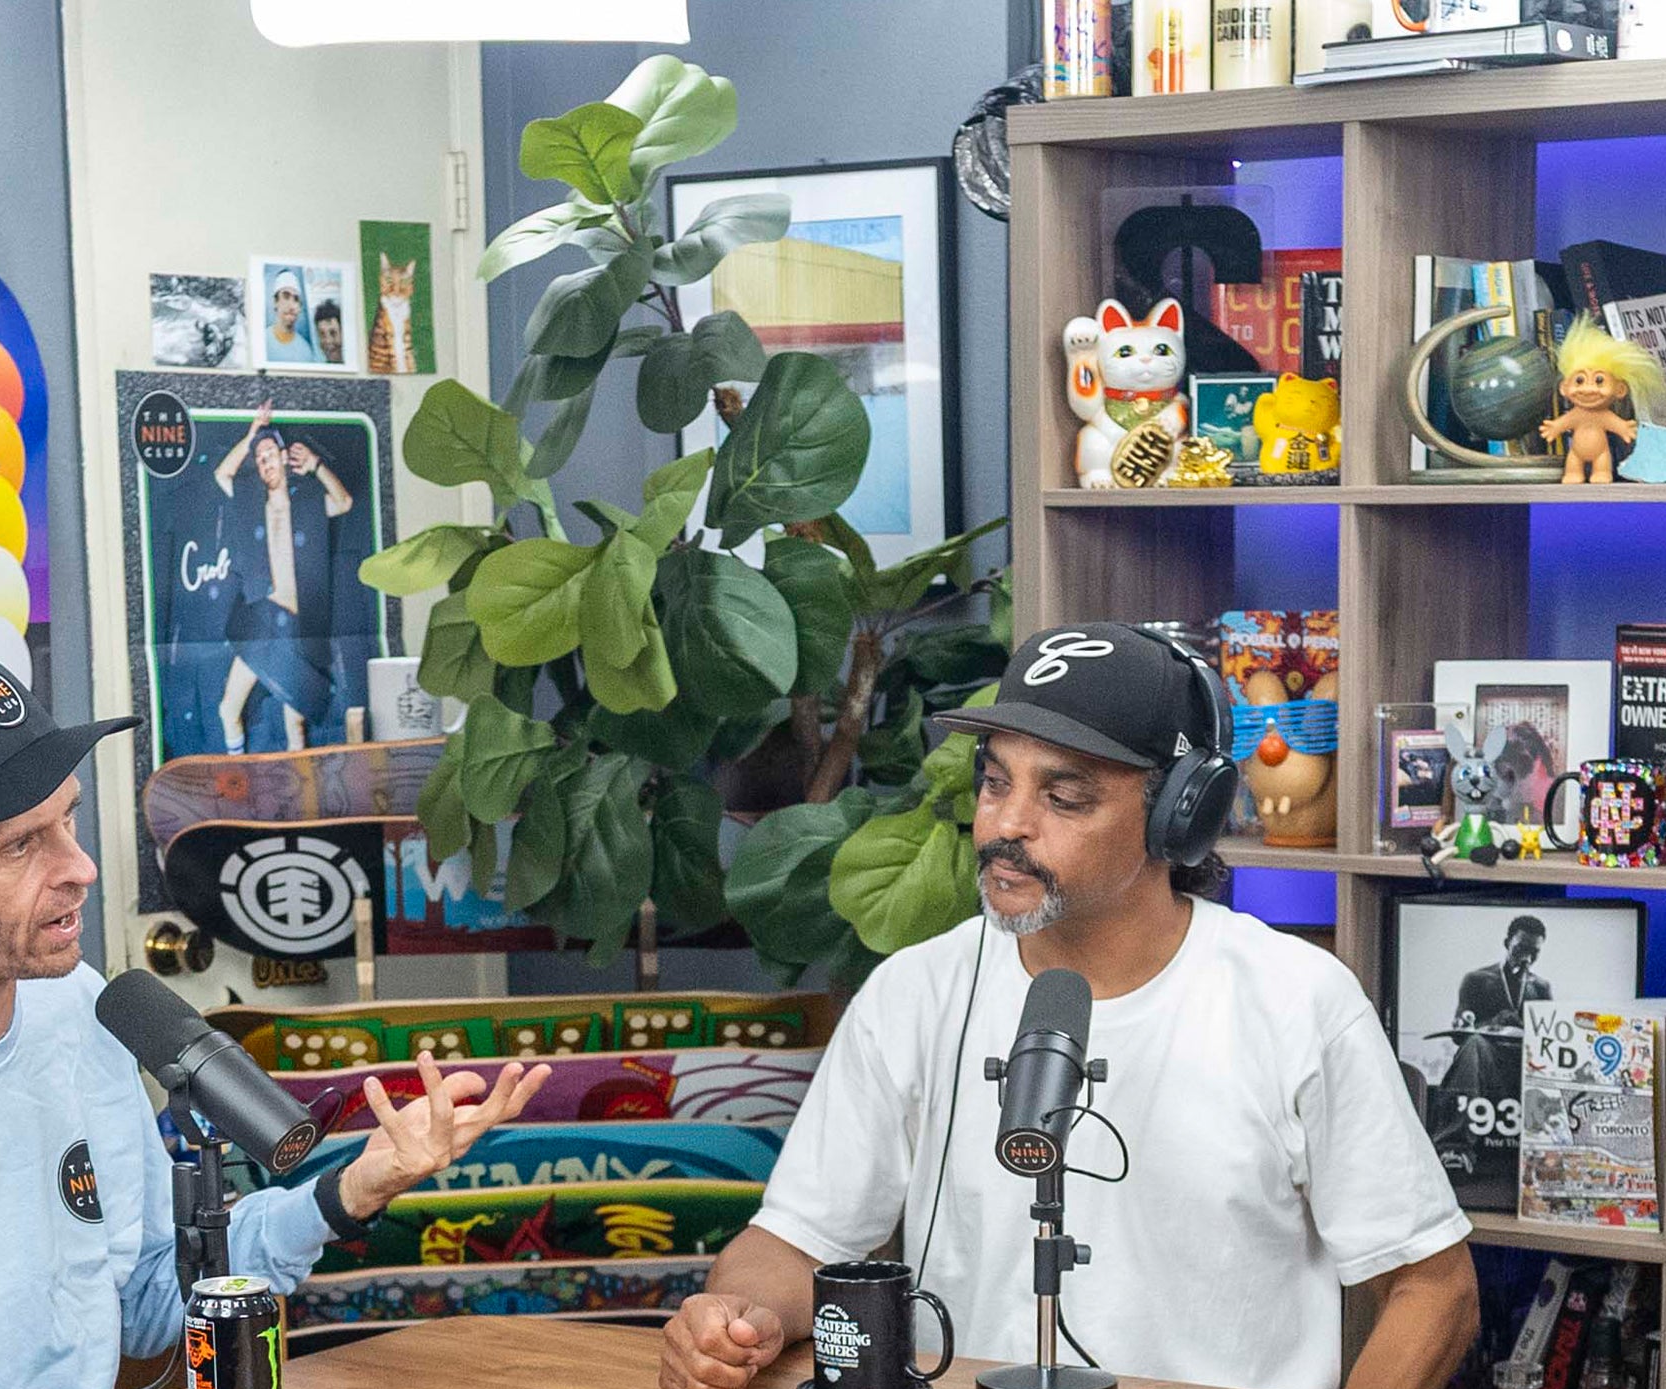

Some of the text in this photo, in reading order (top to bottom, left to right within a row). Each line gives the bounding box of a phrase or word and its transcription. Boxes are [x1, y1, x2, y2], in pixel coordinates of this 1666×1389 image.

[143, 411, 183, 423] THE
[141, 425, 186, 443] NINE
[143, 447, 184, 458] CLUB
[1458, 1095, 1522, 1137] '93
[1595, 1124, 1650, 1137] TORONTO
[283, 1141, 308, 1152] NINE
[1010, 1148, 1048, 1157] NINE
[68, 1161, 92, 1174] TH
